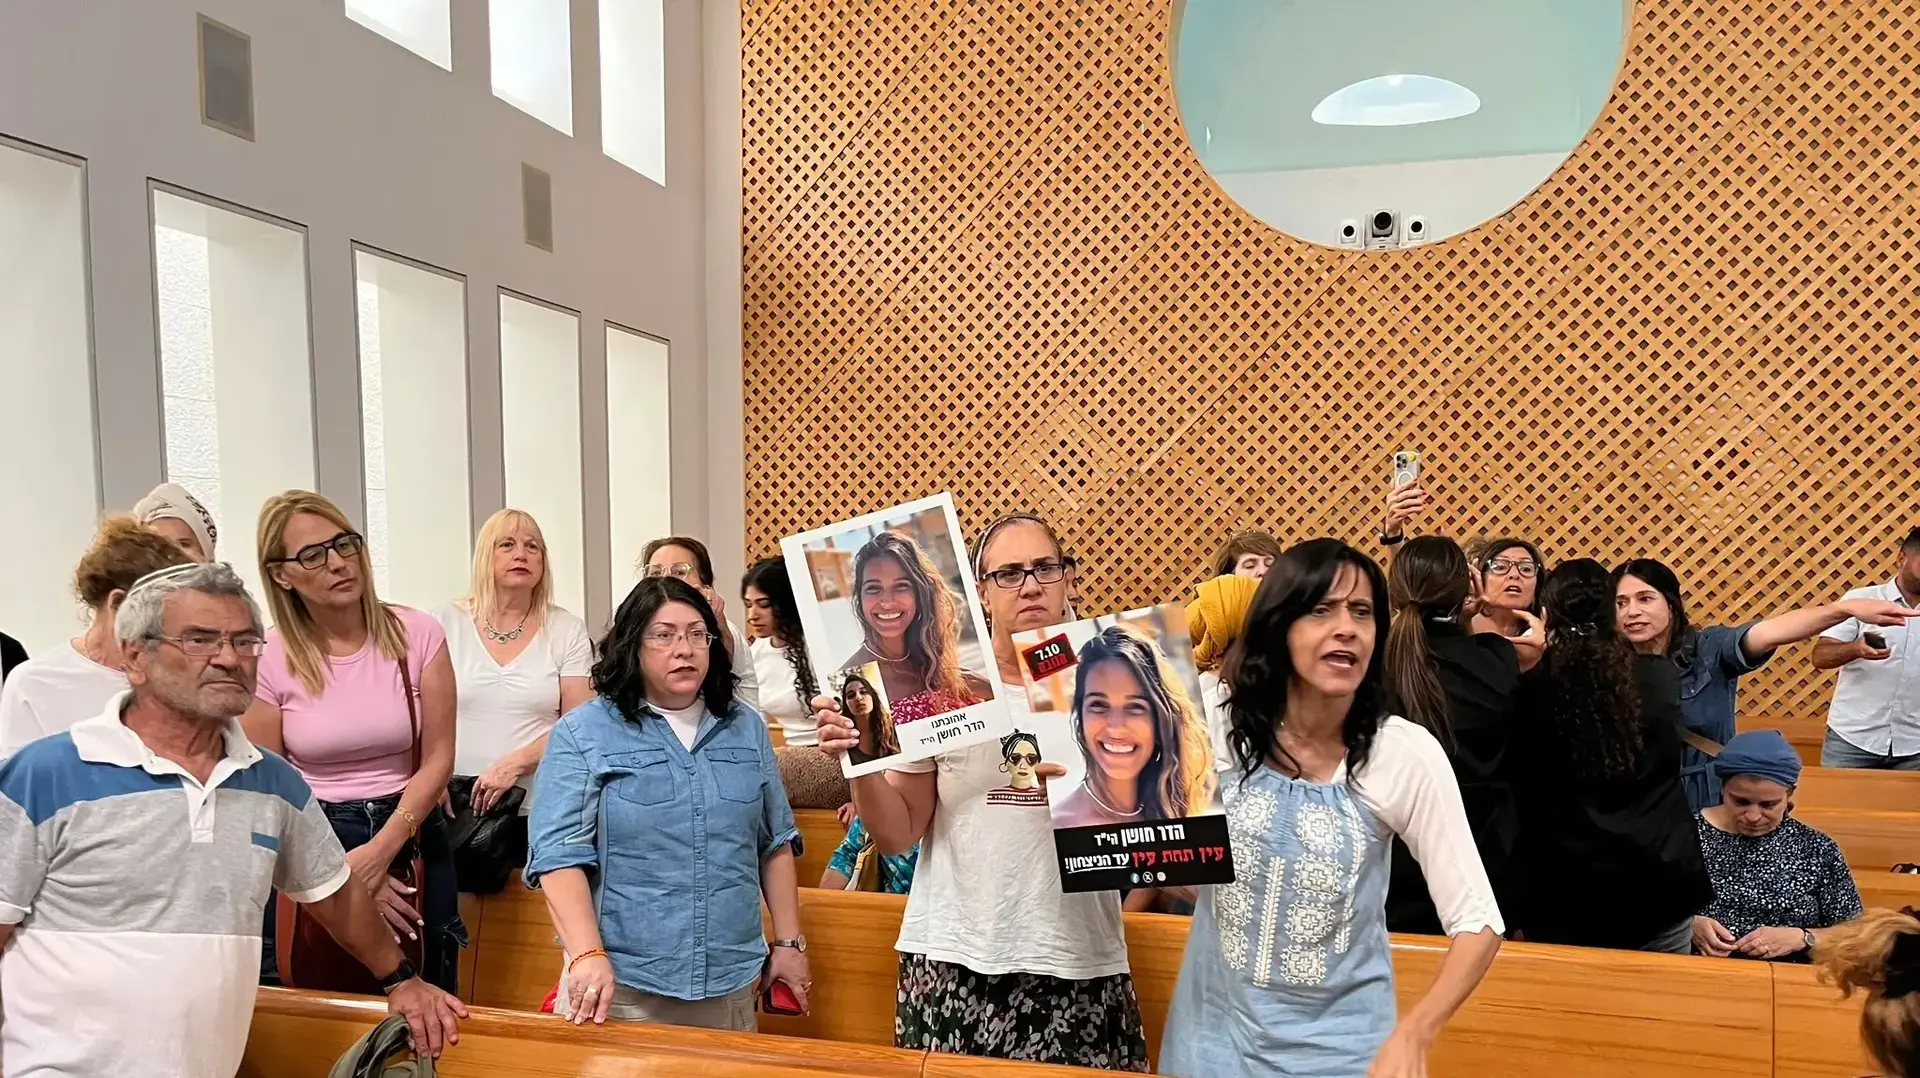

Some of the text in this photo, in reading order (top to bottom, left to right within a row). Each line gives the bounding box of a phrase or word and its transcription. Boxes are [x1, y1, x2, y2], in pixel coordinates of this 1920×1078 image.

[1034, 643, 1060, 661] 7.10
[931, 712, 967, 729] אהובתנו
[964, 720, 986, 733] הדר
[936, 726, 962, 744] חושן
[1093, 823, 1186, 847] הדר חושן הי"ד
[1064, 846, 1224, 872] עין תחת עין עד הניצחון!
